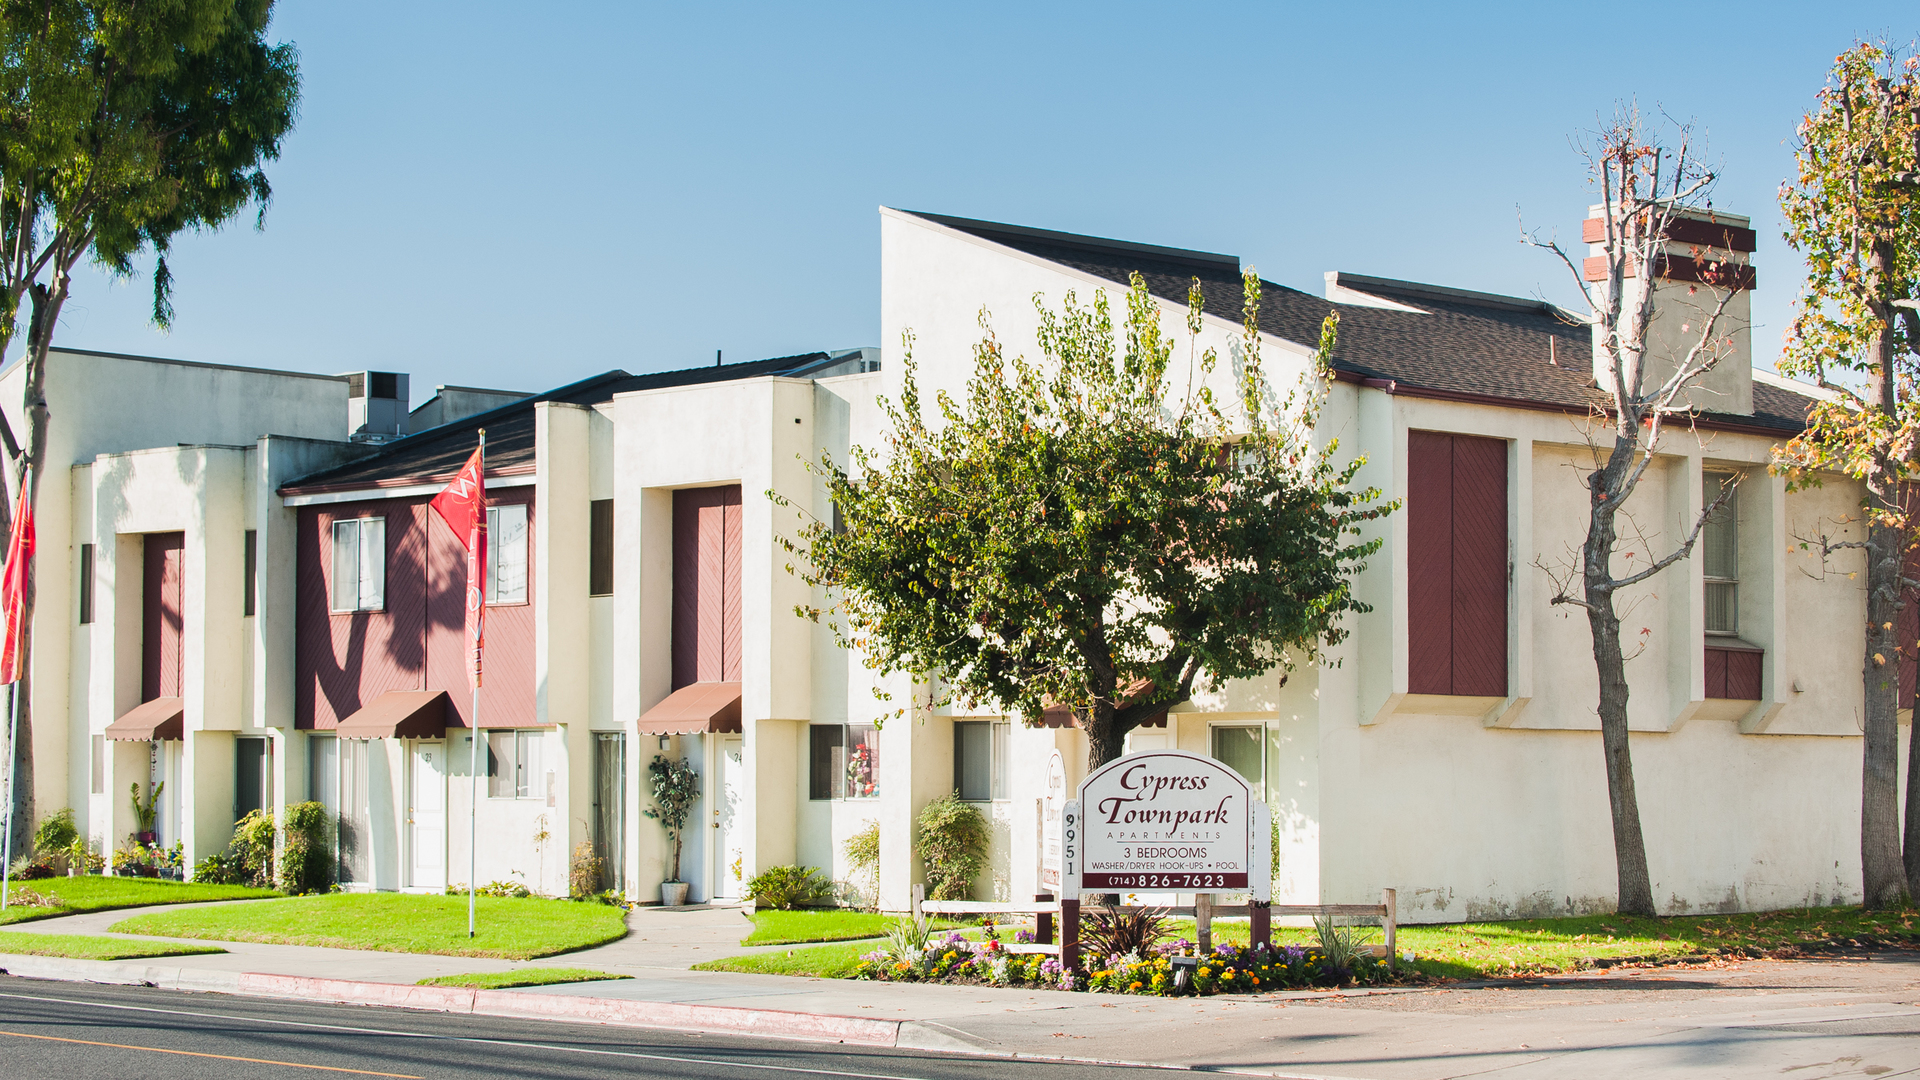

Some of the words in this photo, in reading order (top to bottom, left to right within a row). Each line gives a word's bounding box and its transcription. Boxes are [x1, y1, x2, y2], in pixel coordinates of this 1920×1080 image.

[425, 752, 432, 763] 23
[1120, 764, 1210, 801] Cypress
[1098, 795, 1233, 835] Townpark
[1106, 831, 1221, 839] APARTMENTS
[1065, 813, 1076, 876] 9951
[1123, 847, 1132, 859] 3
[1137, 847, 1208, 859] BEDROOMS
[1091, 861, 1156, 871] WASHER/DRYER
[1159, 861, 1204, 870] HOOK-UPS
[1215, 861, 1239, 870] POOL
[1108, 875, 1136, 886] (714)
[1138, 874, 1225, 887] 826-7623
